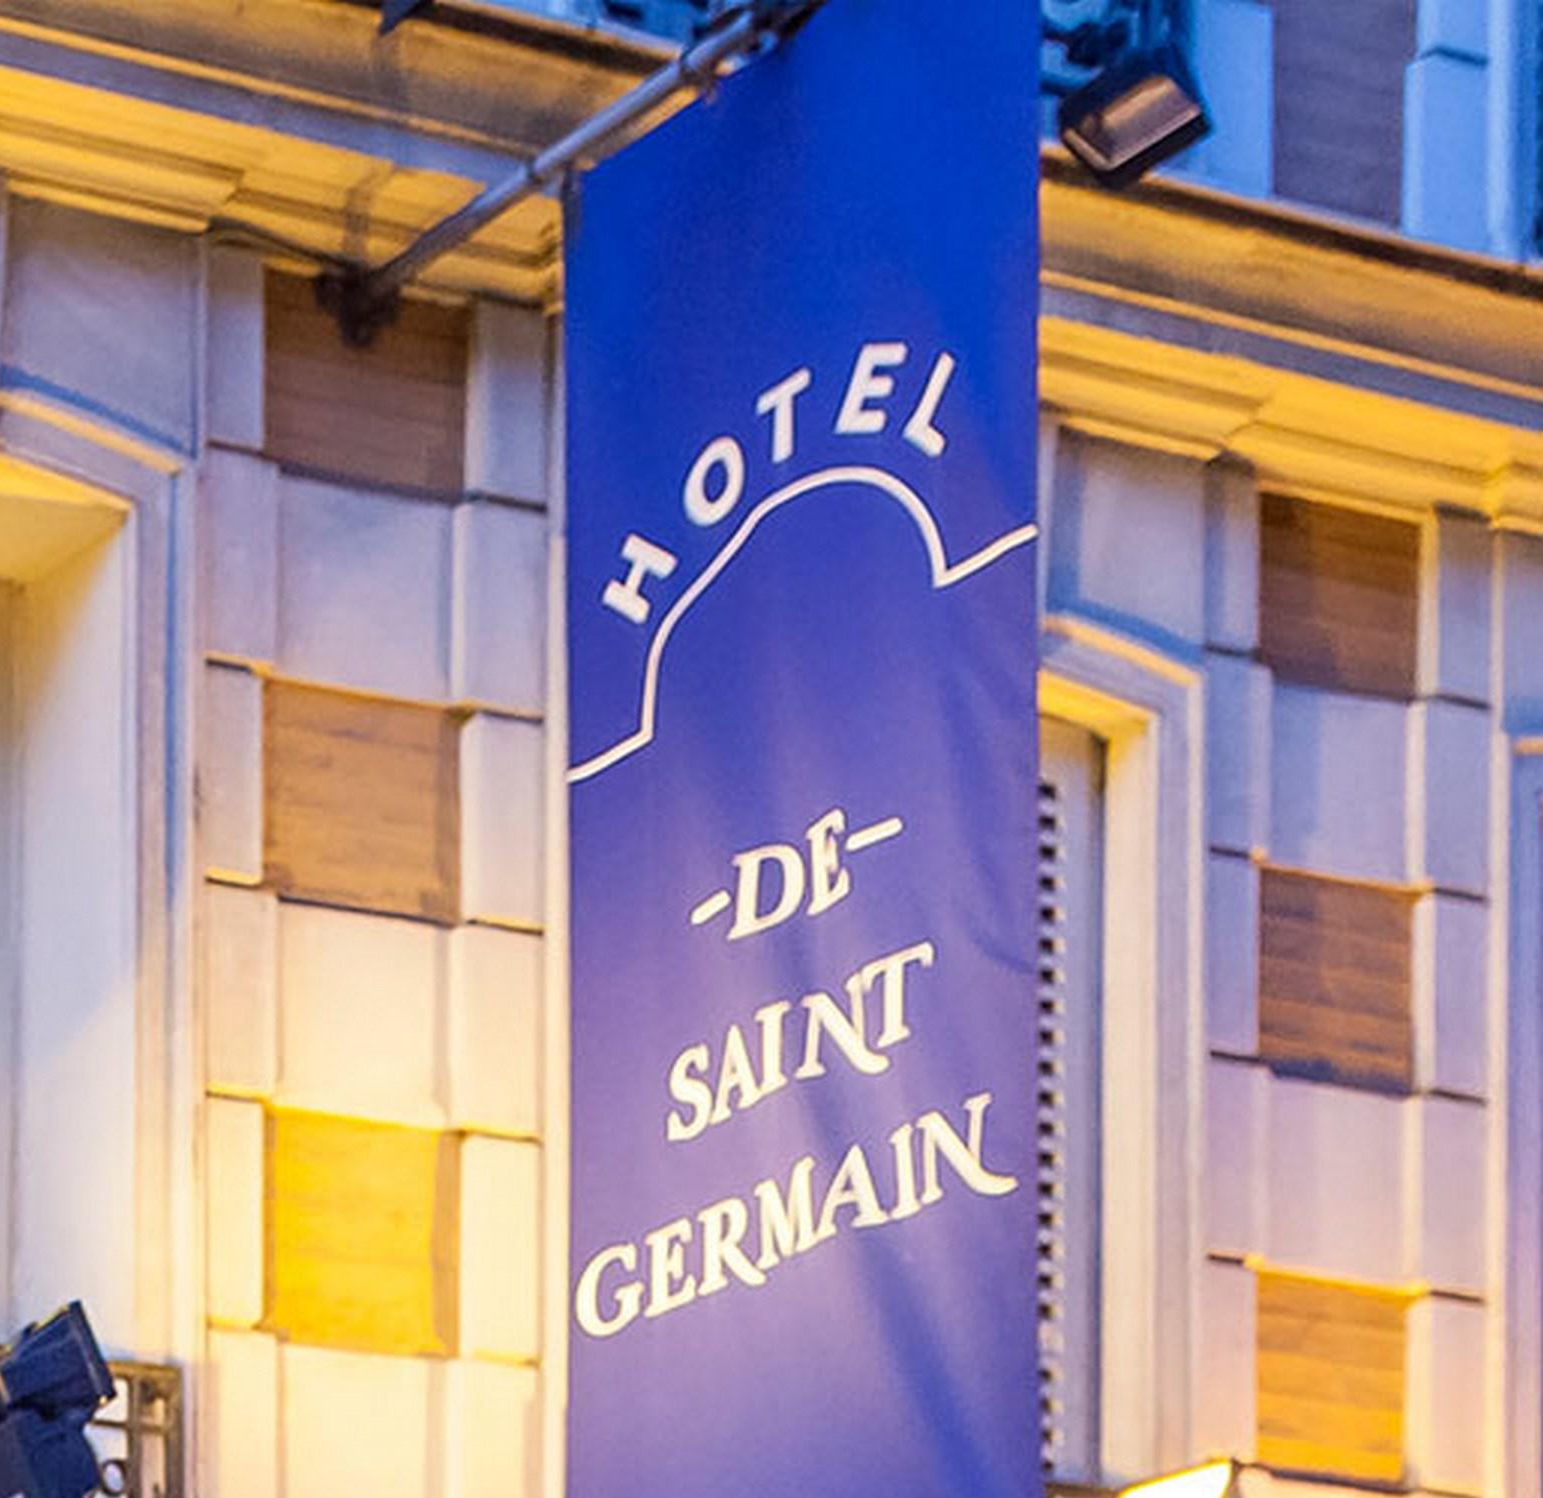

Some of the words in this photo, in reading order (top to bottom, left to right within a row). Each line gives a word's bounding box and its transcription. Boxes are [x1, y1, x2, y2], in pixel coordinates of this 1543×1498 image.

[603, 342, 956, 626] HOTEL
[667, 942, 936, 1142] SAINT
[574, 1092, 1019, 1338] GERMAIN
